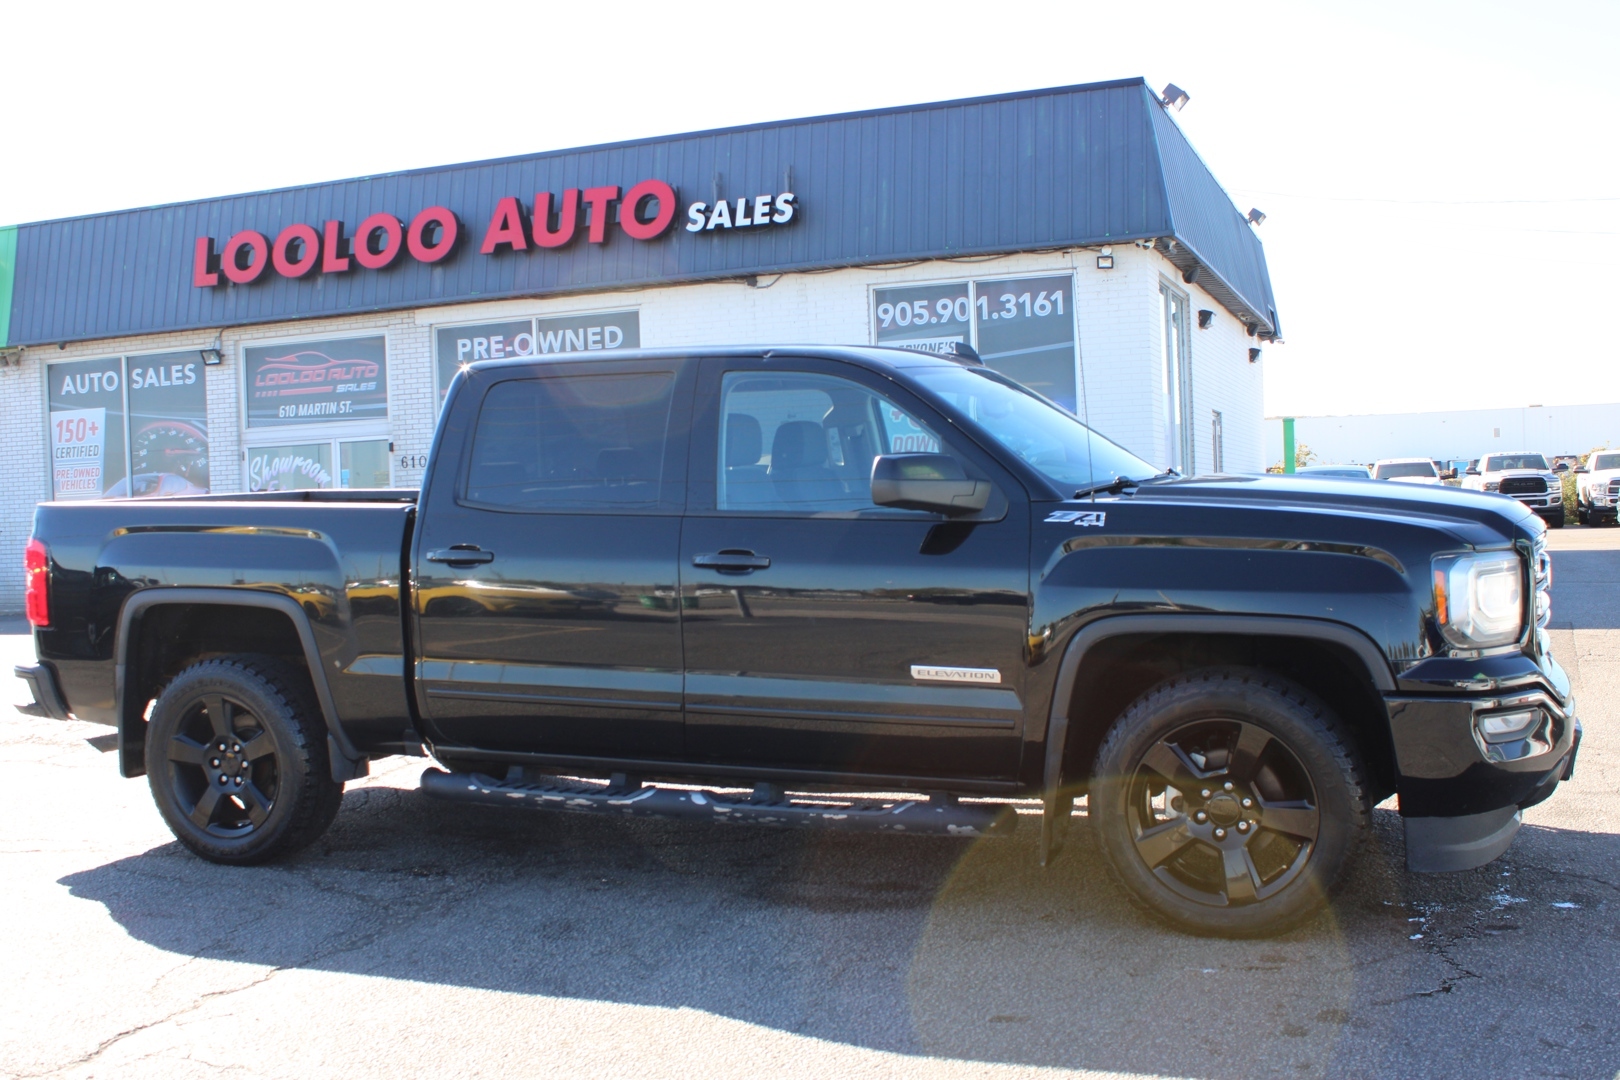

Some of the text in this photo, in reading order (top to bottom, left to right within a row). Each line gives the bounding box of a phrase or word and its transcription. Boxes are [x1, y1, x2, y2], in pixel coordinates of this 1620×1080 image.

[194, 178, 795, 288] LOOLOO AUTO SALES
[877, 290, 1064, 328] 905.901.3161
[457, 325, 623, 361] PRE-OWNED
[61, 364, 196, 395] AUTO SALES
[255, 365, 379, 387] LOOLOO AUTO
[336, 381, 377, 393] SALES
[278, 400, 353, 418] 610 MARTIN ST.
[56, 417, 99, 444] 150+
[55, 444, 100, 460] CERTIFIED
[401, 455, 427, 468] 610
[56, 467, 100, 480] PRE-OWNED
[250, 454, 332, 491] Showroom
[61, 478, 96, 491] VEHICLES
[917, 669, 995, 680] ELEVATION
